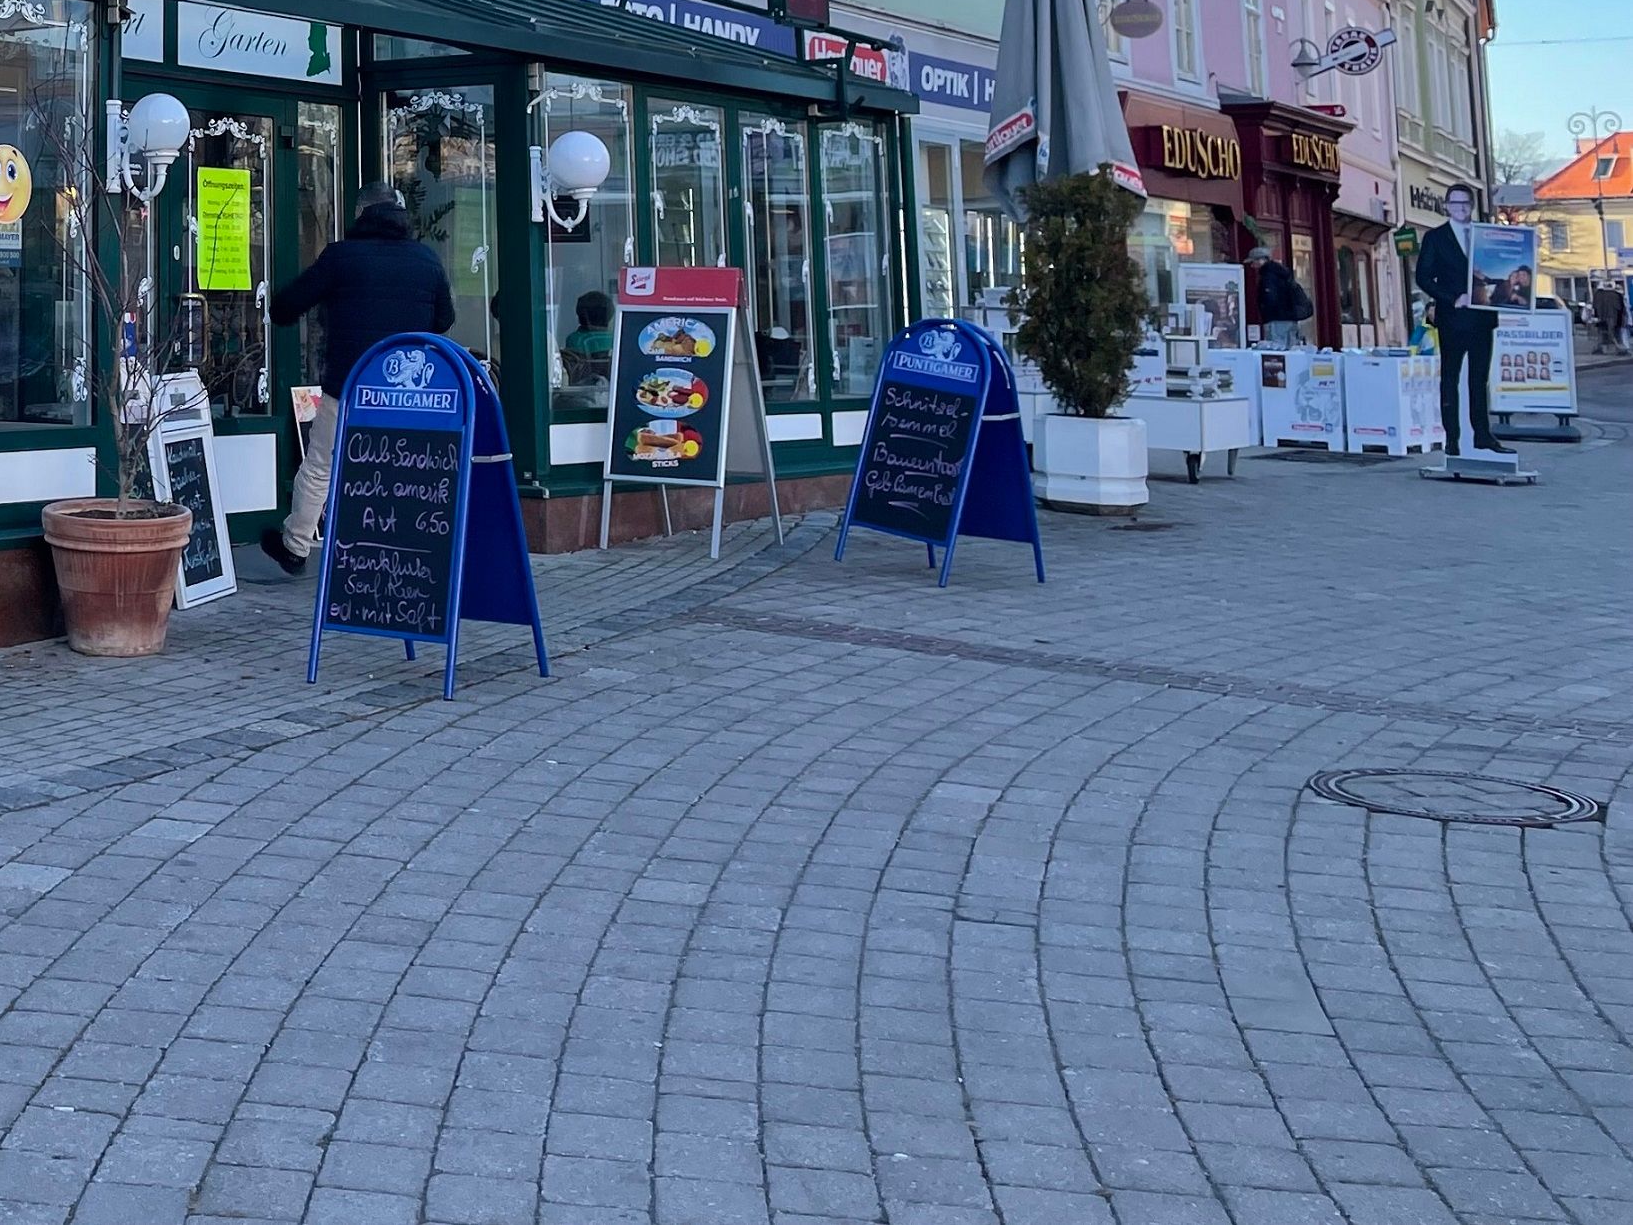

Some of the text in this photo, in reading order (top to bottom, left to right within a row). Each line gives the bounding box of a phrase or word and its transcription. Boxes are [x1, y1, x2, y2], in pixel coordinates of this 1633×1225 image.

[198, 5, 288, 59] Garten
[921, 65, 969, 98] OPTIK
[1161, 124, 1242, 181] EDUSCHO
[1291, 132, 1341, 173] EDUSCHO
[898, 353, 973, 380] PUNTIGAMER
[361, 388, 452, 409] PUNTIGAMER
[344, 471, 389, 497] nach
[362, 602, 392, 624] mit
